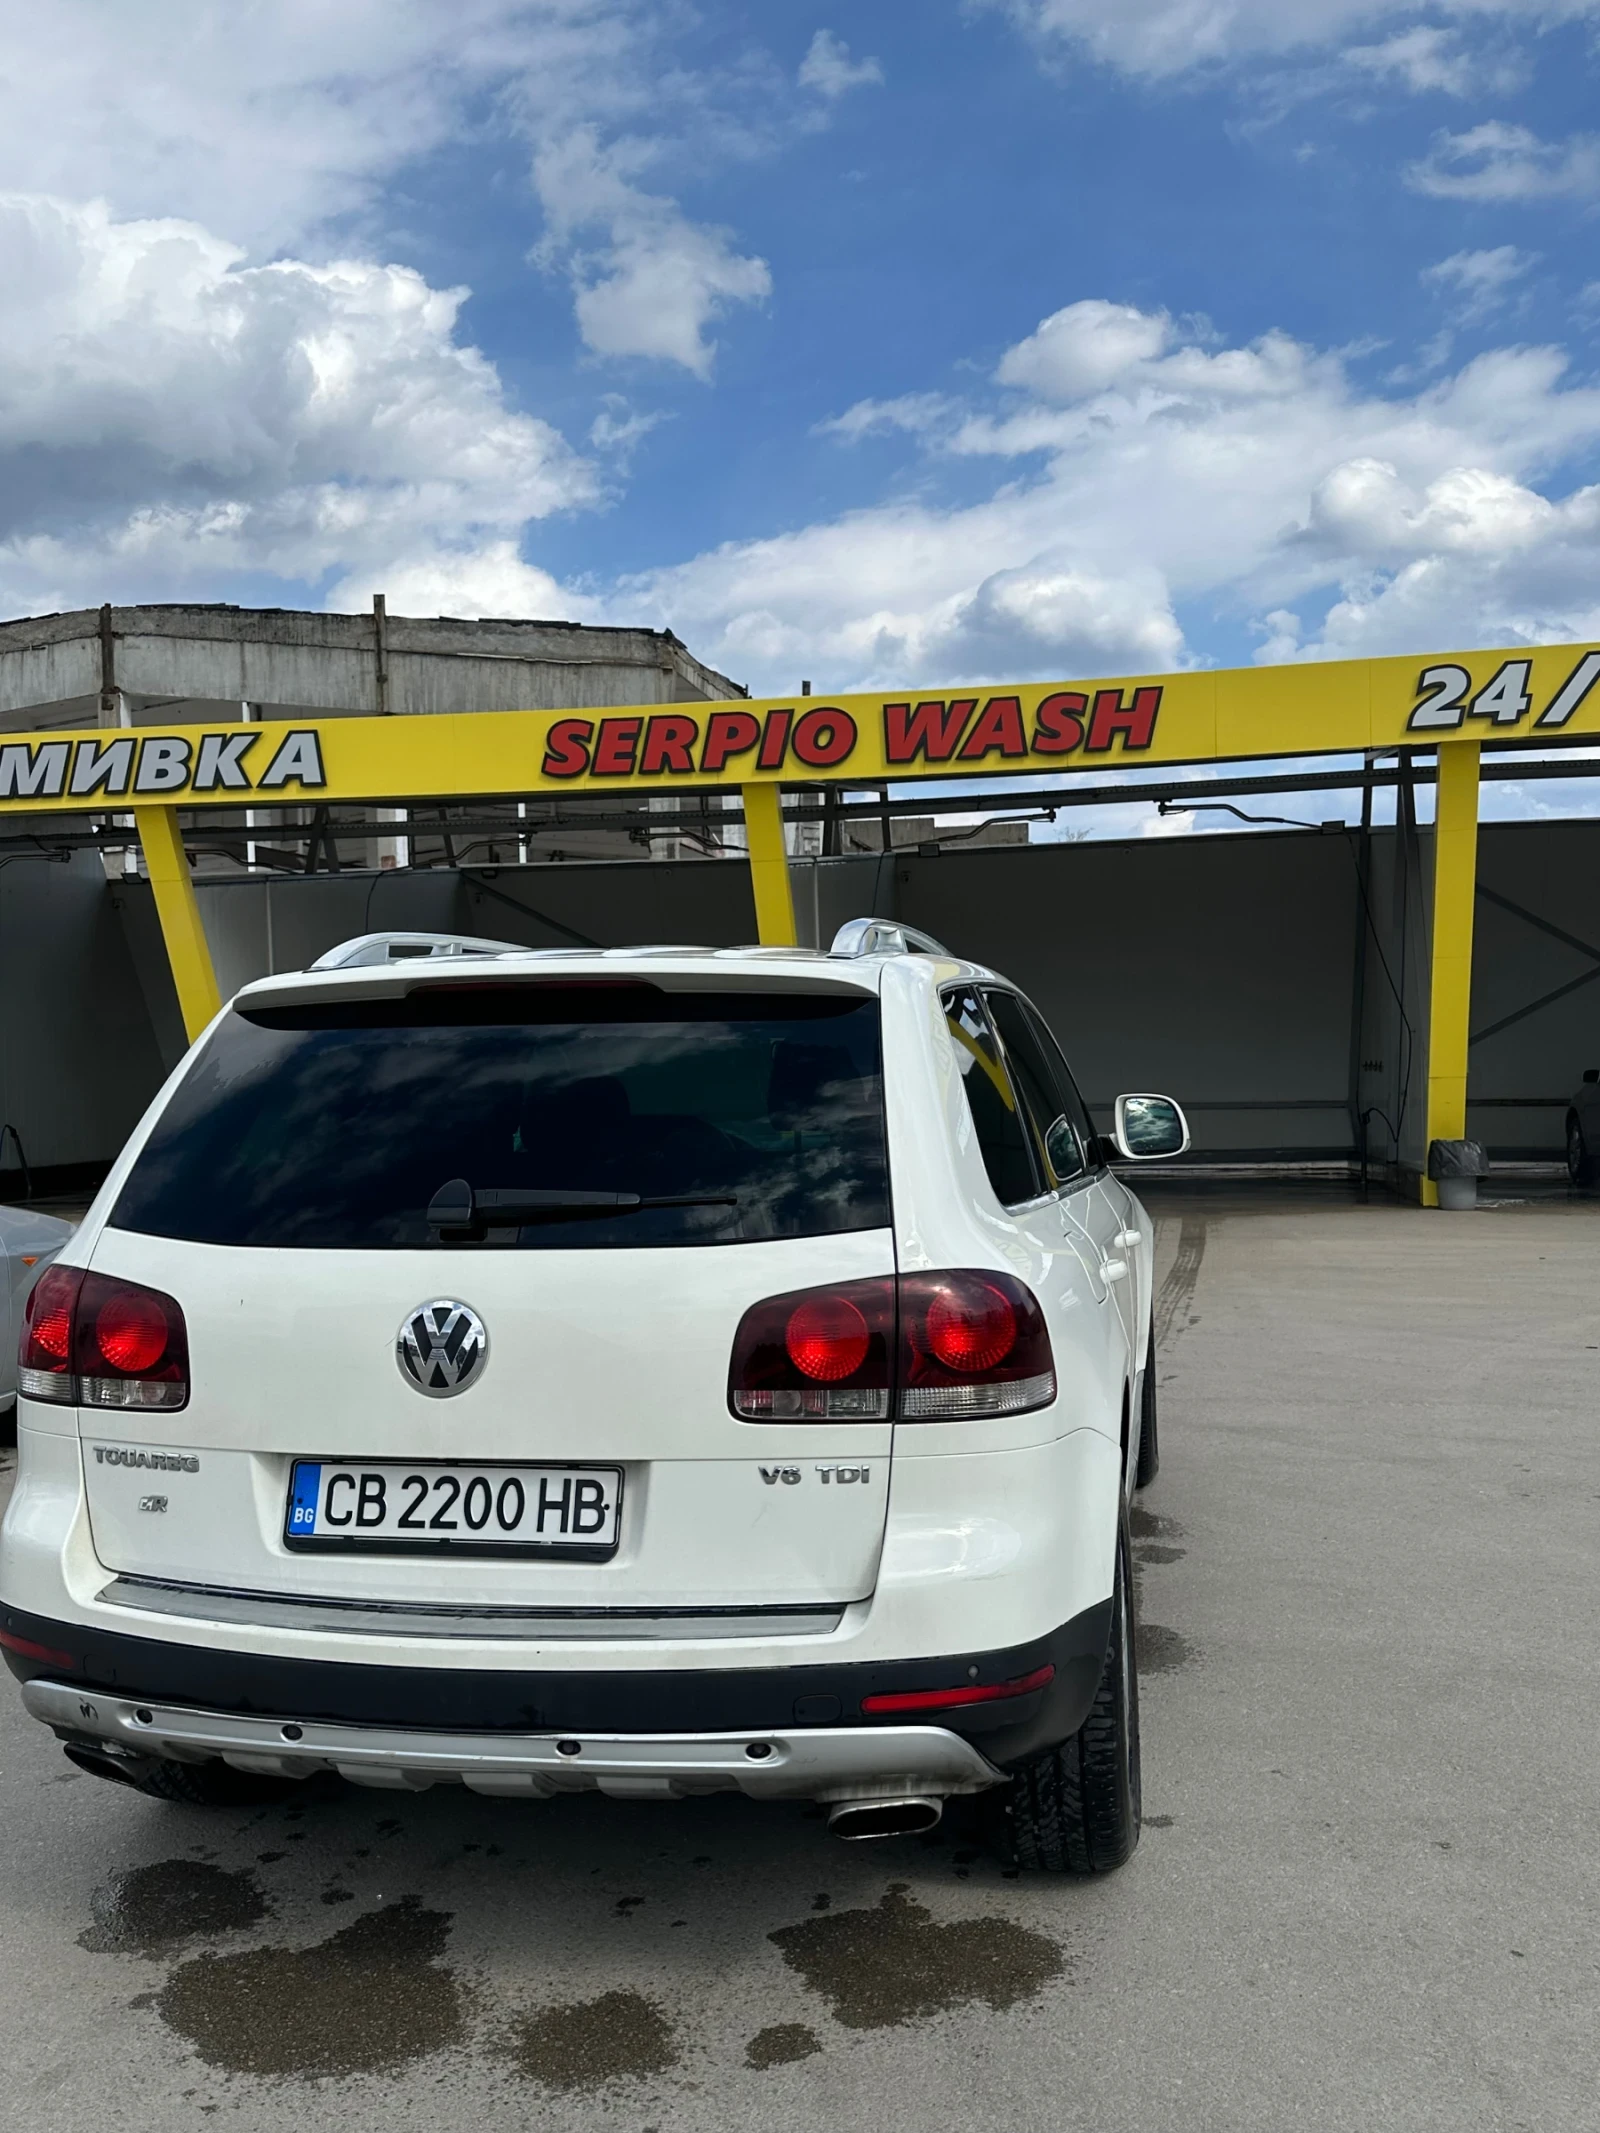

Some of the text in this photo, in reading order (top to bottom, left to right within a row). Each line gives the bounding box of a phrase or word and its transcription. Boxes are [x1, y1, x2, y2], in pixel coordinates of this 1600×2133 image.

[541, 685, 1164, 779] SERPIO WASH
[399, 1299, 486, 1396] VW
[93, 1445, 200, 1473] TOUAREG
[758, 1464, 870, 1485] V6 TDI
[293, 1507, 315, 1525] BG
[324, 1473, 606, 1535] CB 2200 HB
